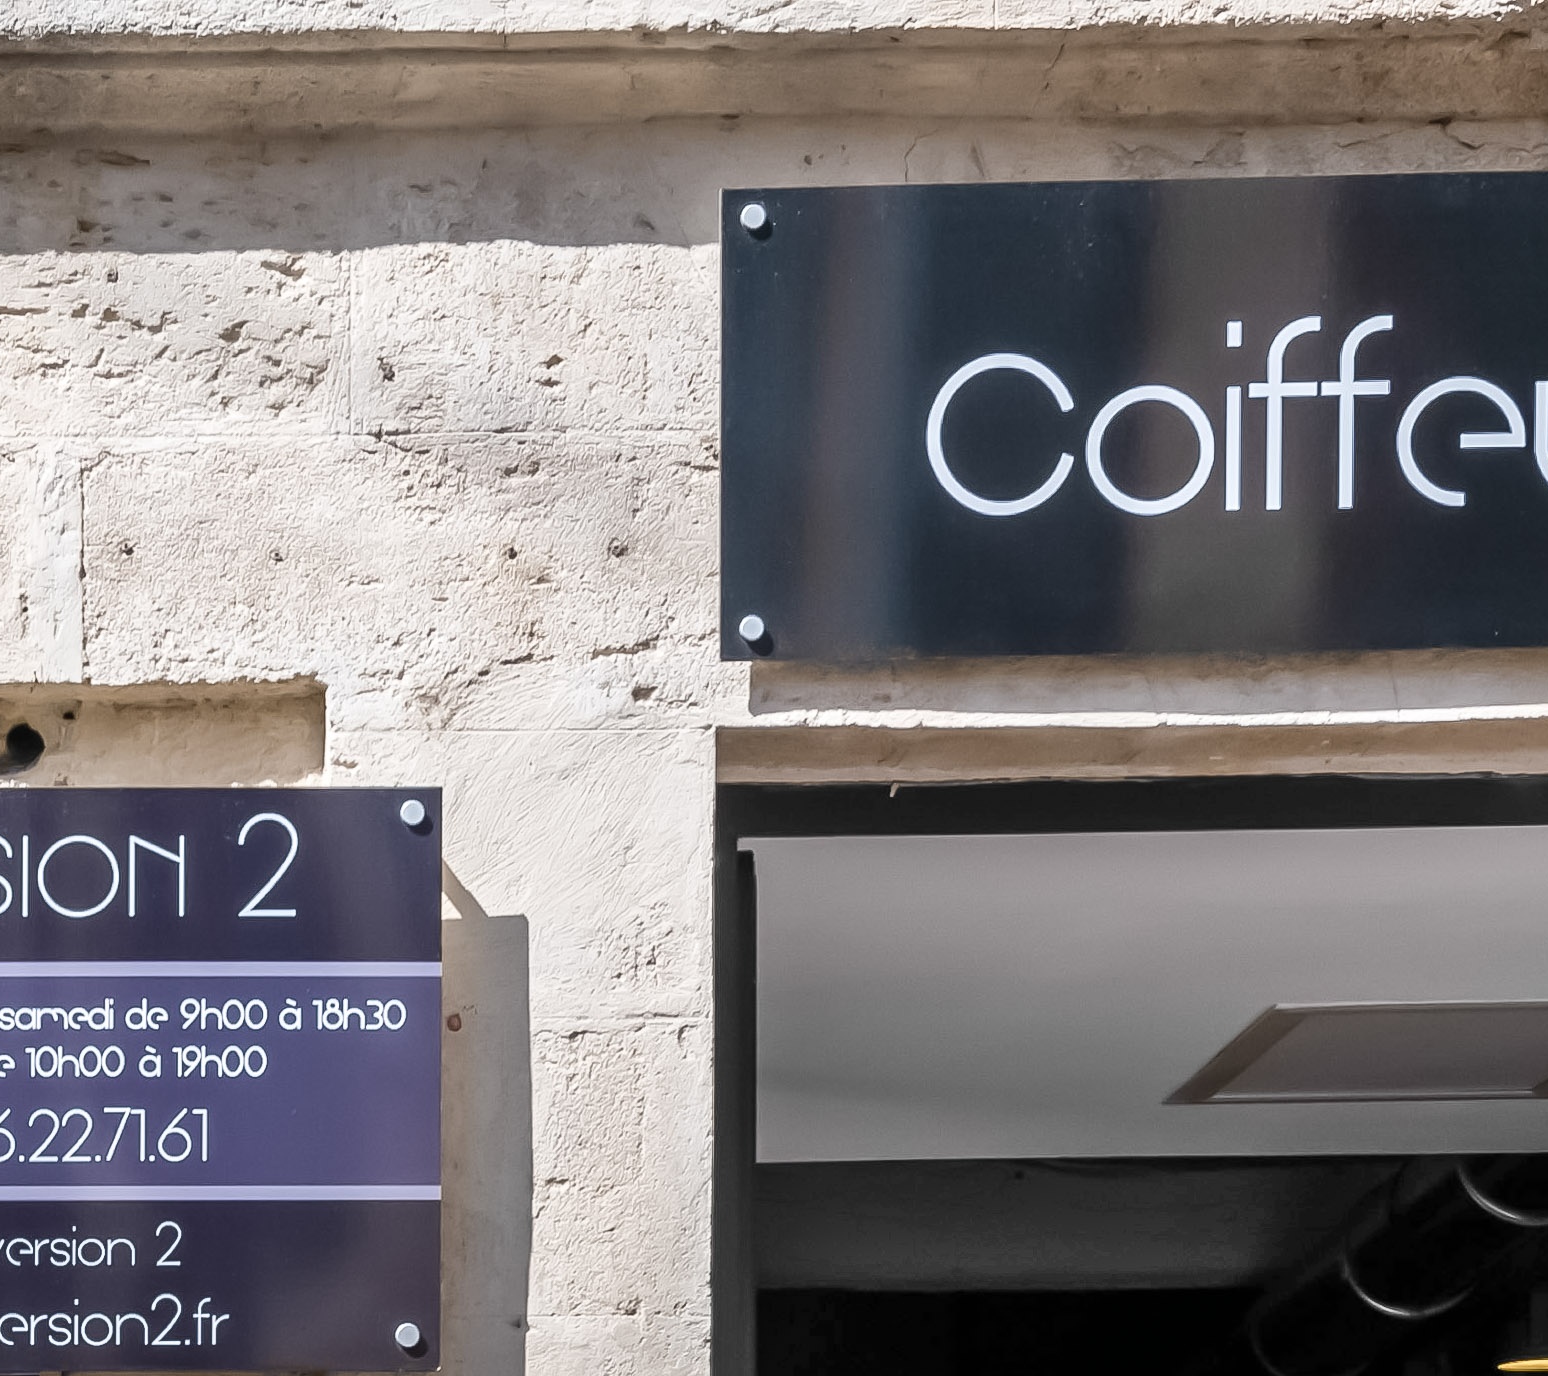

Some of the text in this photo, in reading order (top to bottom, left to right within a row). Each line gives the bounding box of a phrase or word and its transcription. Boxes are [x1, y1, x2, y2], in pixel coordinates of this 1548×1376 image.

[237, 812, 299, 918] 2
[124, 997, 169, 1030] de
[179, 997, 268, 1030] 9h00
[278, 998, 302, 1031] à
[311, 998, 407, 1031] 18h30
[24, 1045, 126, 1078] 10h00
[138, 1045, 162, 1078] à
[171, 1044, 268, 1078] 19h00
[155, 1220, 182, 1267] 2
